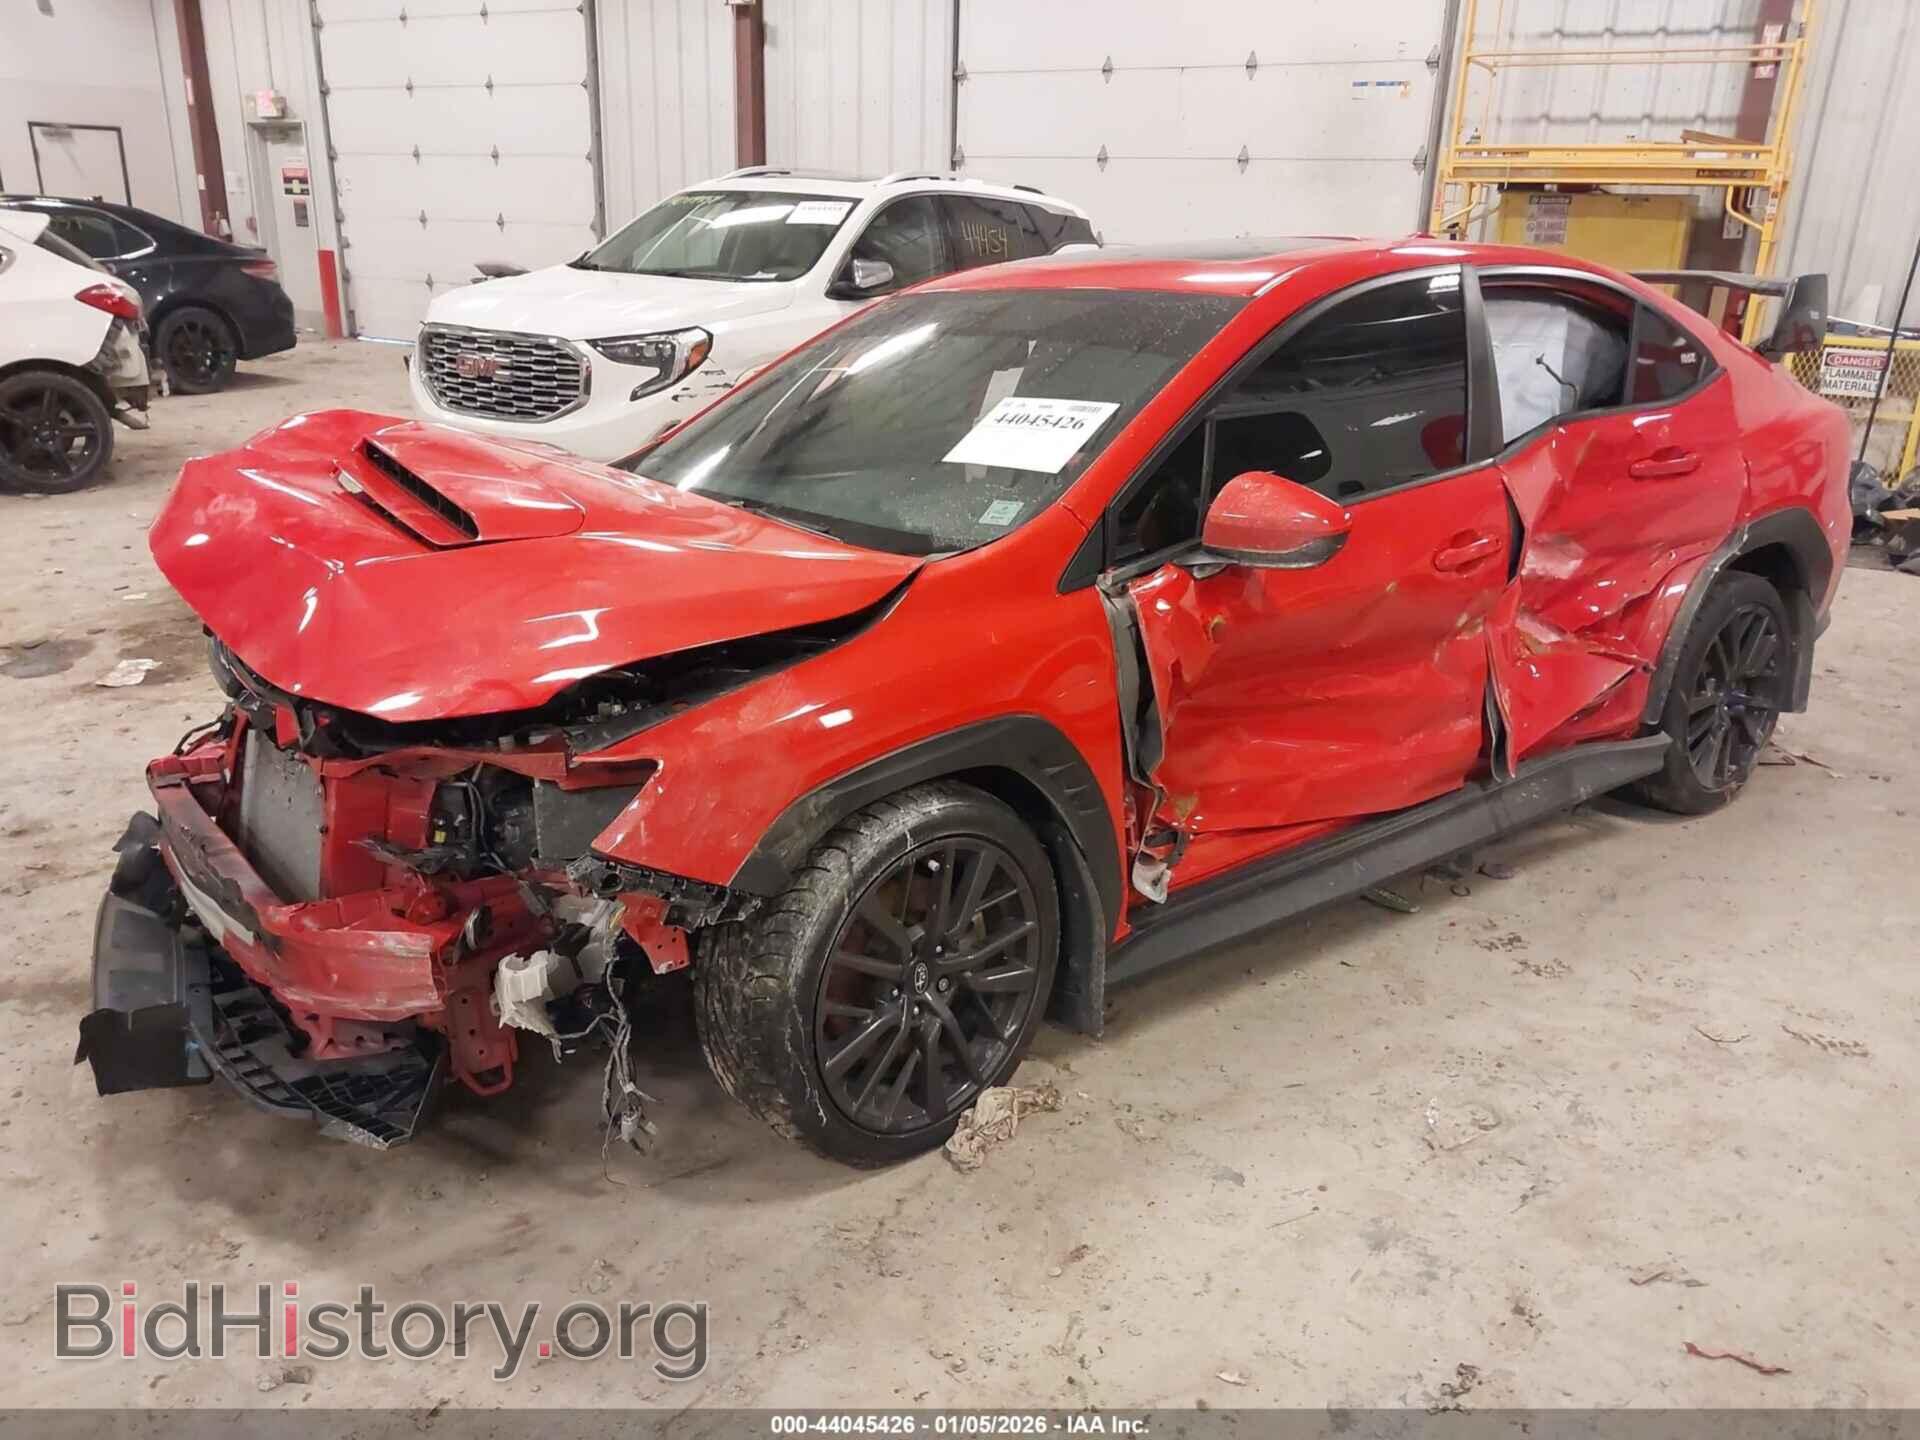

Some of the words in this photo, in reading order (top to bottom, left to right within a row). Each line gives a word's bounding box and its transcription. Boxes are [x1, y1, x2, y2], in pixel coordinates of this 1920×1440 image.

[961, 221, 1008, 258] 44454
[1834, 355, 1881, 367] DANGER
[1825, 367, 1882, 380] FLAMMABL
[994, 413, 1086, 430] 44045426
